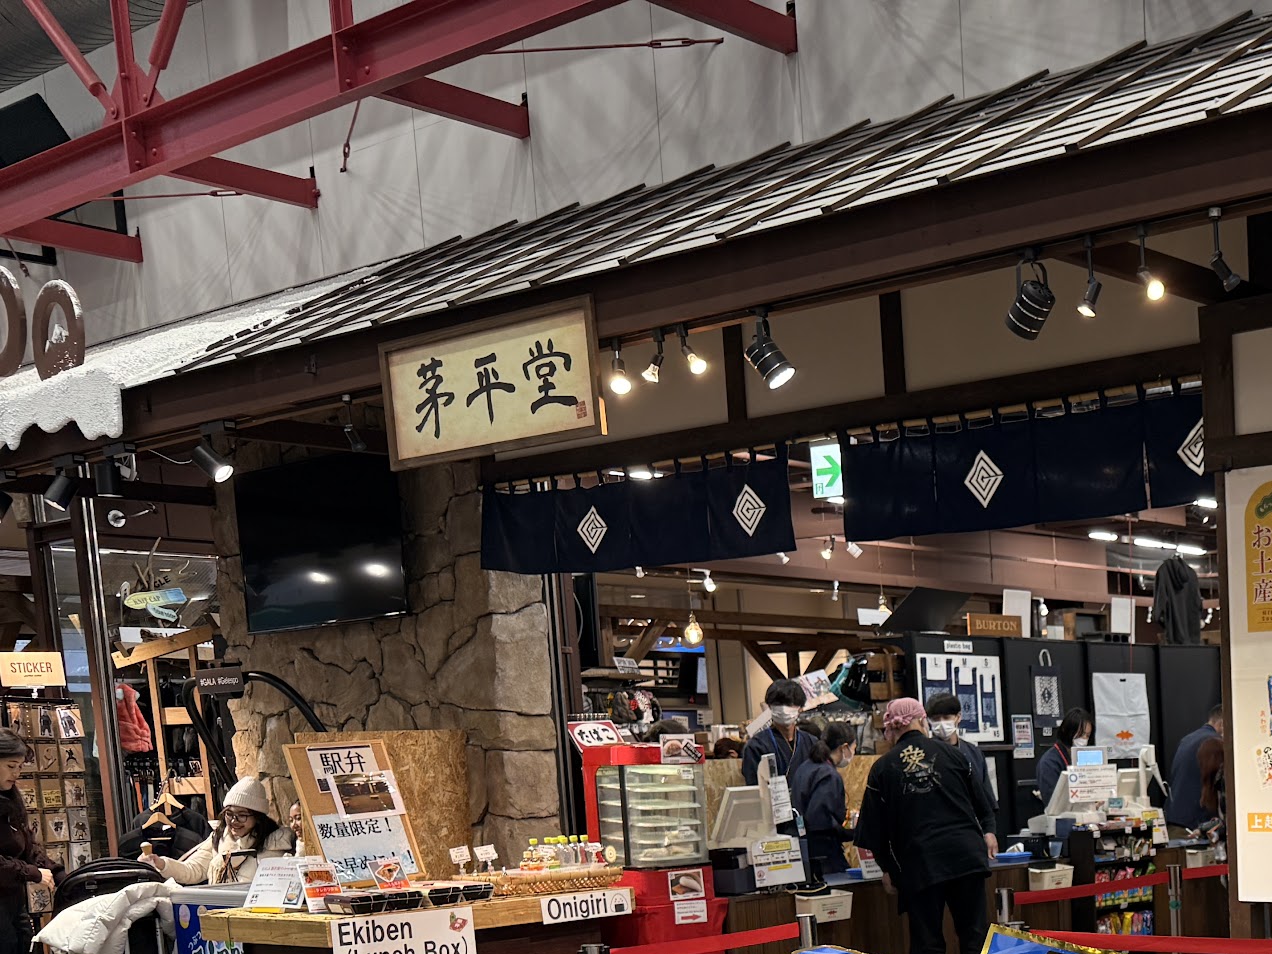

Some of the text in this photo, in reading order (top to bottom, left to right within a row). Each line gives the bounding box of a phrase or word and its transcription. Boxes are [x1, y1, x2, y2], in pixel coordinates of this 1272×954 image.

[414, 338, 578, 440] 茅平堂
[1252, 524, 1272, 604] お土産
[976, 619, 1017, 631] BURTON
[10, 661, 53, 674] STICKER
[200, 678, 217, 688] #GALA
[577, 728, 615, 743] たばこ
[320, 751, 366, 774] 駅弁
[547, 891, 608, 922] Onigiri
[338, 920, 413, 947] Ekiben
